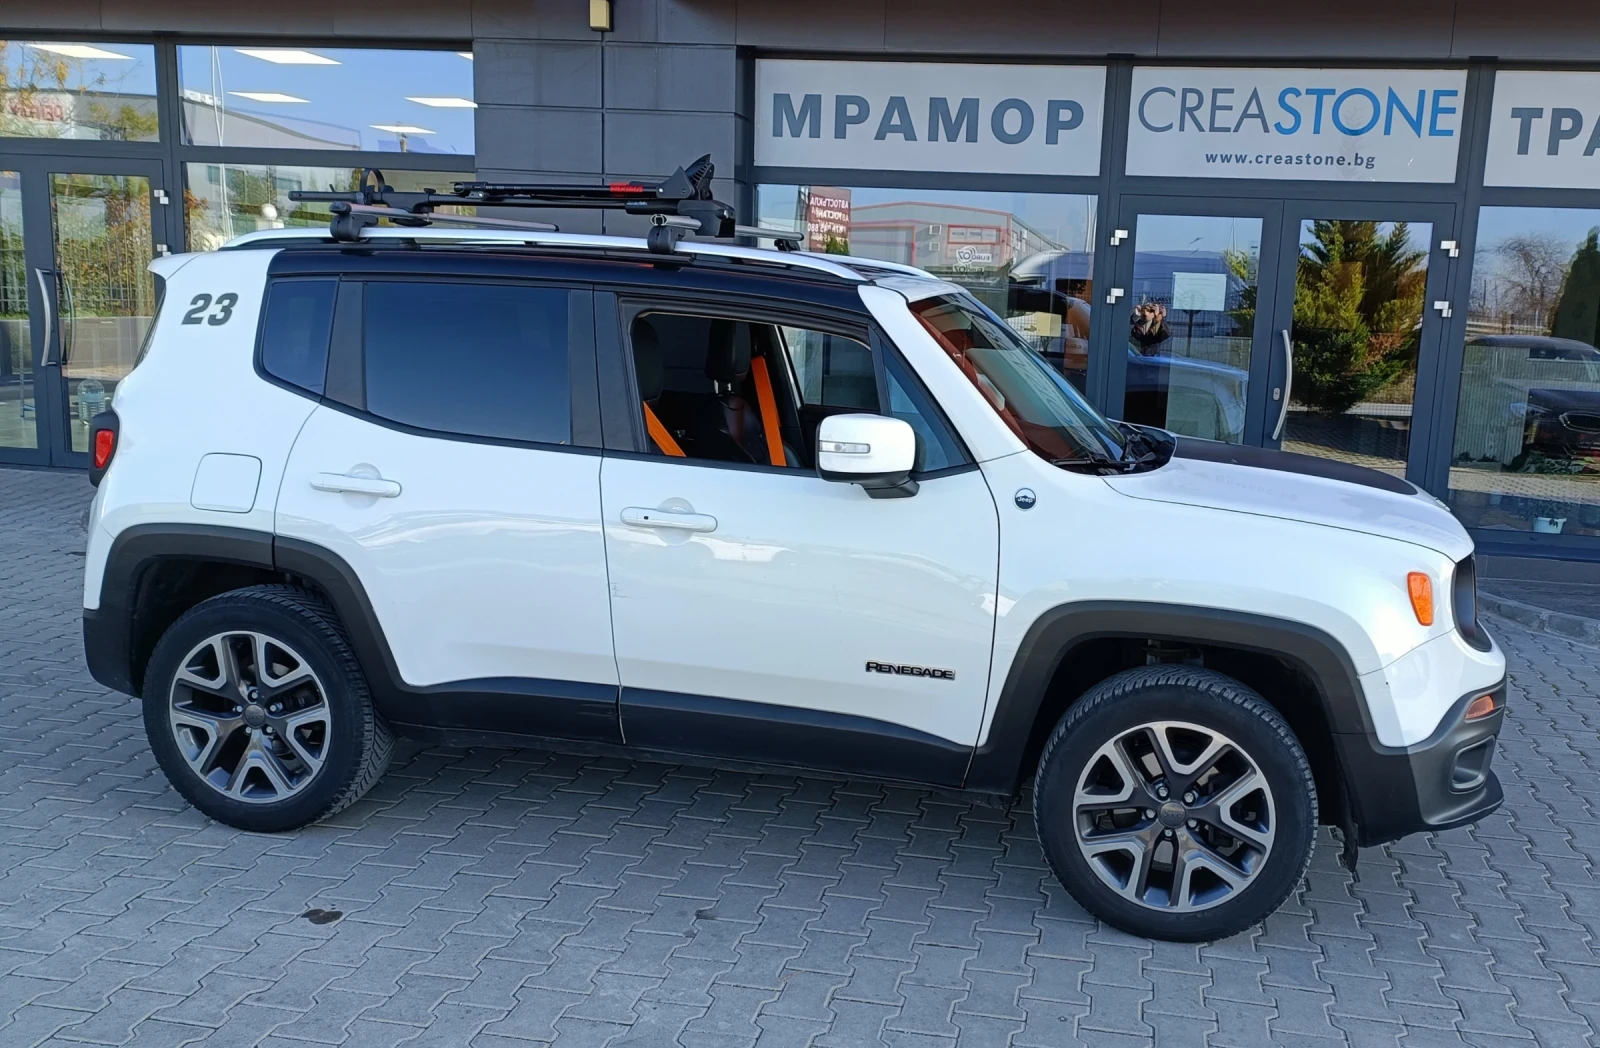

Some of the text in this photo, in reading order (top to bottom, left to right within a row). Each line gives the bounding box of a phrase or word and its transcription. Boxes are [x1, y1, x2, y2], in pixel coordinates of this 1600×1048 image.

[772, 93, 1084, 145] МРАМОР
[1138, 86, 1458, 138] CREASTONE
[1205, 152, 1376, 168] www.creastone.bg
[181, 292, 239, 326] 23
[865, 661, 955, 681] RENEGADE
